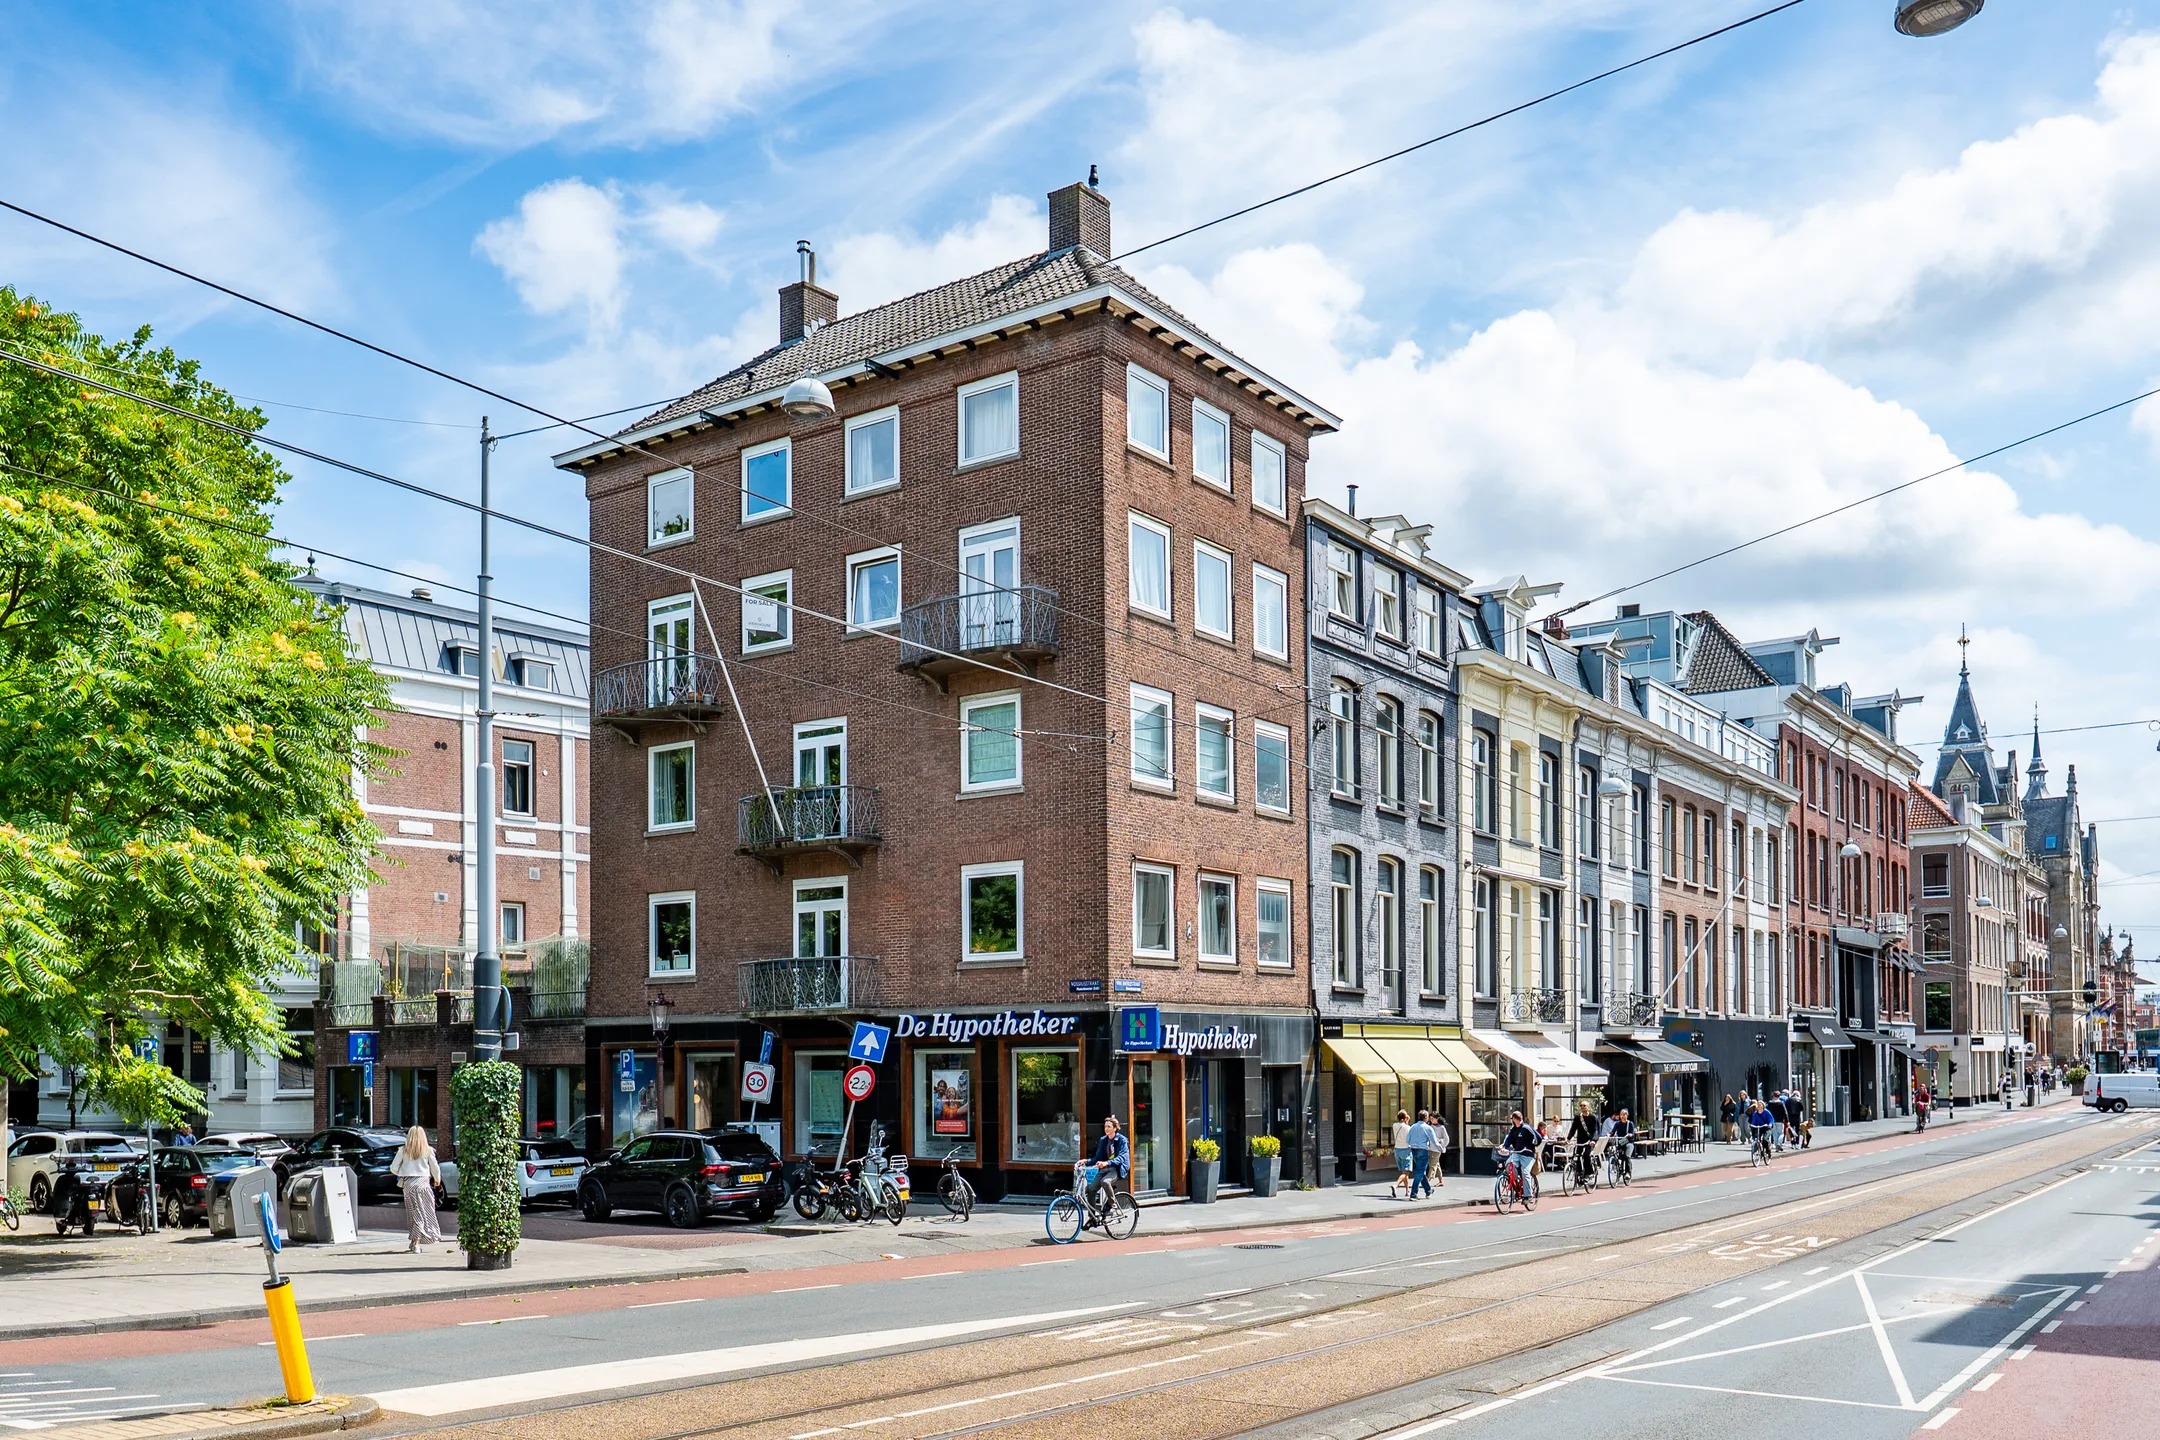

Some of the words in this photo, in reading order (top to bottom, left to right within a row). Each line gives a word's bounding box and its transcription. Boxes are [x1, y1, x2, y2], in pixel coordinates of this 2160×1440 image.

[894, 1014, 926, 1037] De
[929, 1010, 1076, 1043] Hypotheker
[1163, 1024, 1257, 1055] Hypotheker
[623, 1053, 630, 1068] P
[749, 1077, 764, 1087] 30
